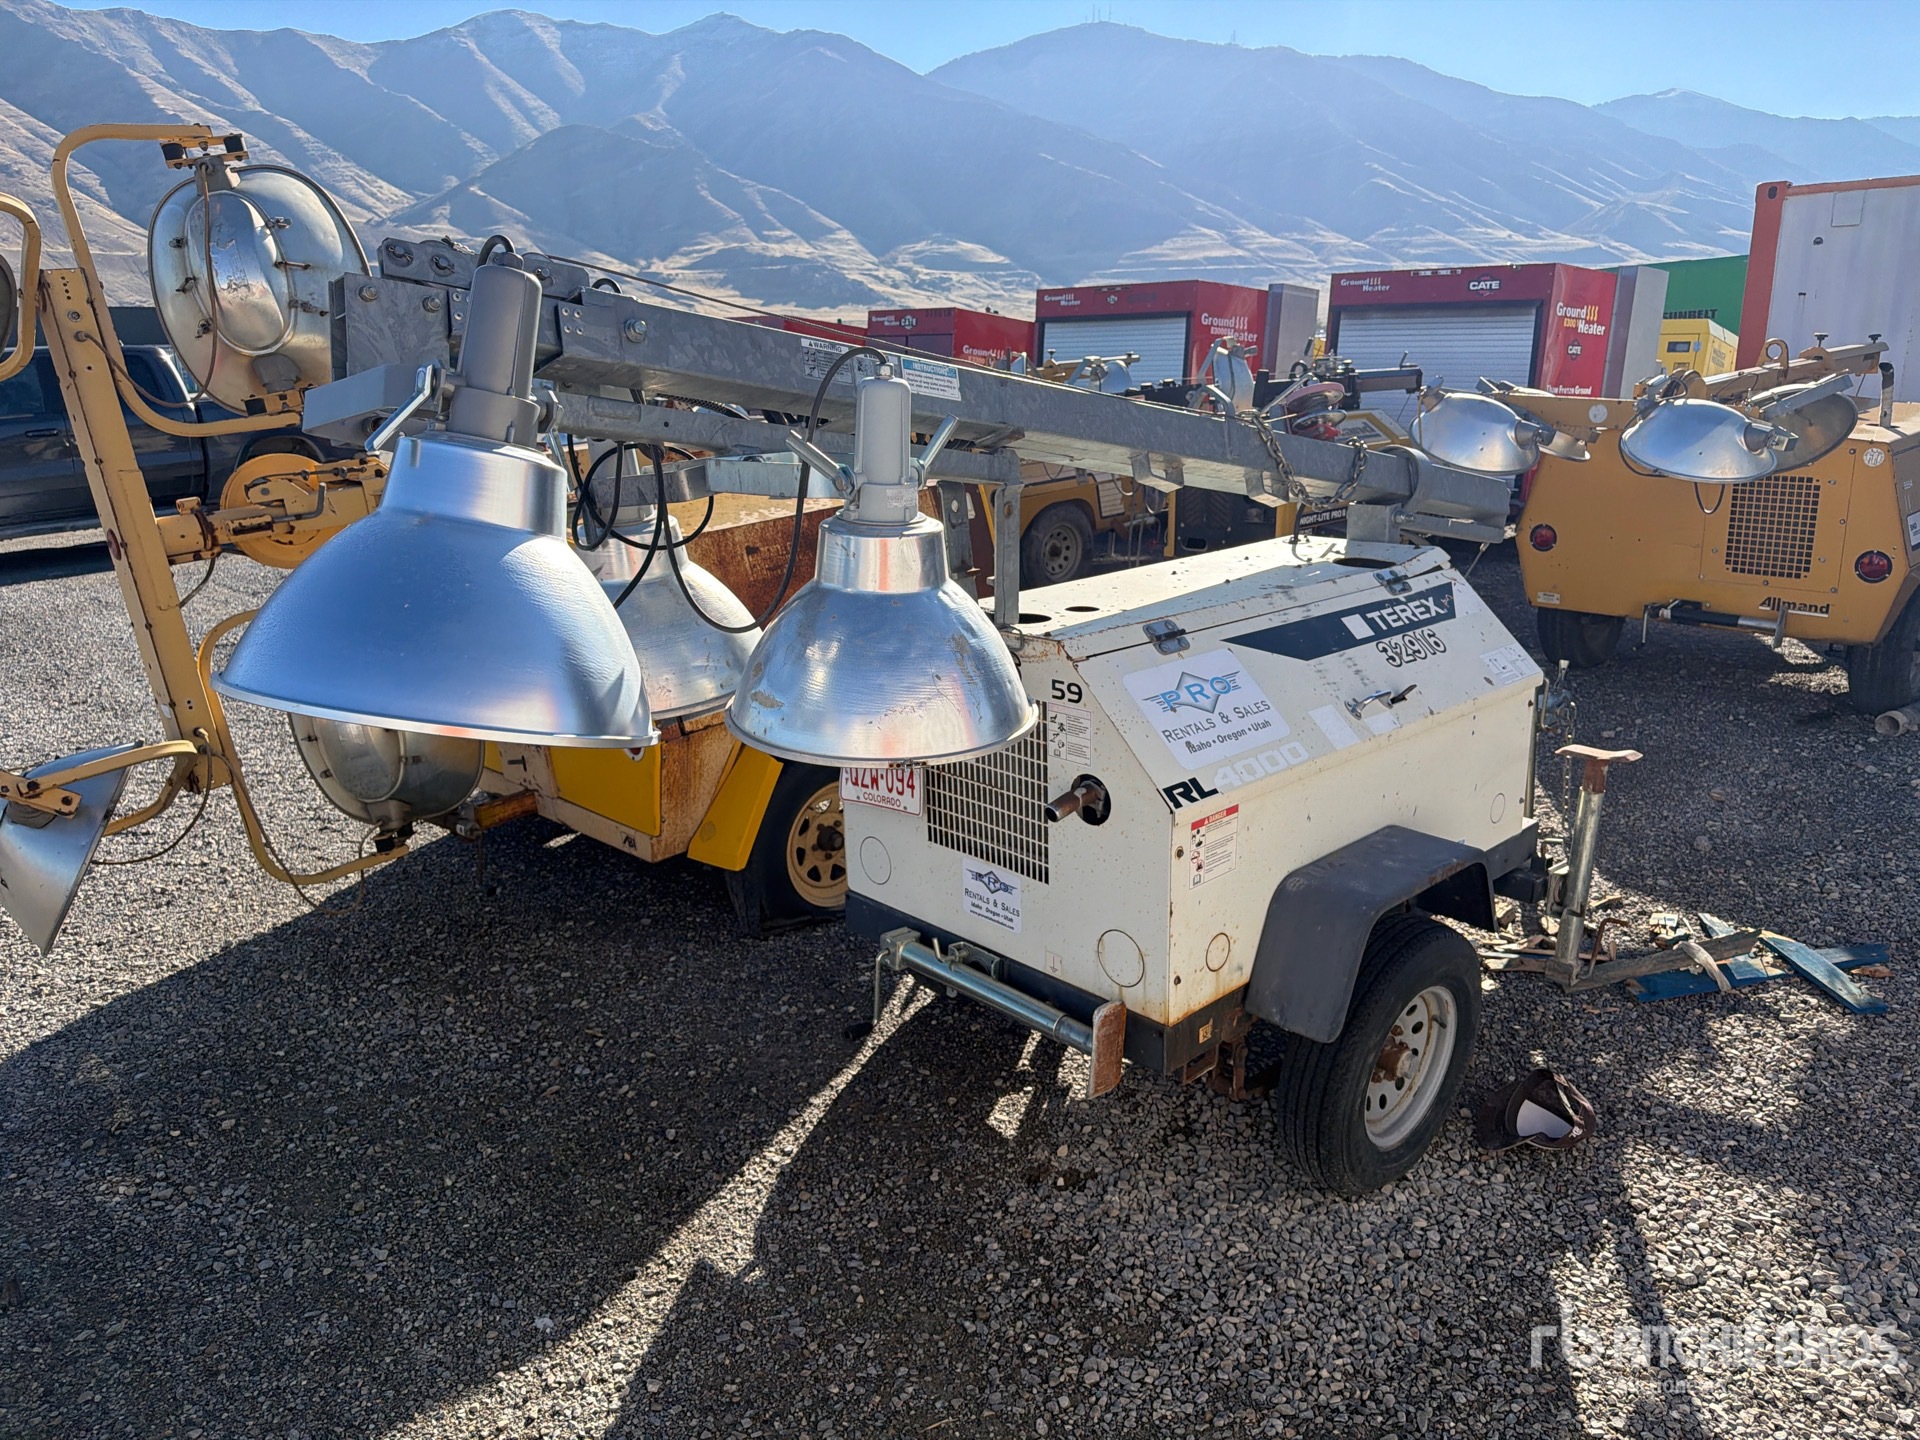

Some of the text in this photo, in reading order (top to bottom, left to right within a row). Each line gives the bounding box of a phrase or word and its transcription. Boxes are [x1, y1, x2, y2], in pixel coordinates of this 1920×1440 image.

[1341, 278, 1369, 286] Ground
[1469, 280, 1499, 290] CATE
[1557, 302, 1587, 318] Ground
[1201, 313, 1235, 327] Ground
[1578, 319, 1606, 336] Heater
[1228, 329, 1258, 342] Heater
[813, 342, 842, 352] WARNING
[1568, 346, 1581, 354] CATE
[1300, 511, 1330, 525] NIGHT-LITE
[1331, 509, 1341, 519] PRO
[1759, 597, 1830, 614] Allmand
[1366, 597, 1446, 631] TEREX
[1376, 629, 1447, 667] 32916
[1051, 679, 1083, 704] 59
[1160, 676, 1232, 709] PRO
[1161, 700, 1271, 743] RENTALS & SALES
[1187, 719, 1271, 754] Idaho Oregon Utah
[1162, 741, 1309, 809] RL 4000
[863, 792, 901, 807] COLORADO
[1209, 810, 1227, 822] DANGER
[965, 888, 1020, 917] RENTALS & SALES
[985, 907, 1000, 917] Oregon
[1003, 914, 1014, 923] Utah
